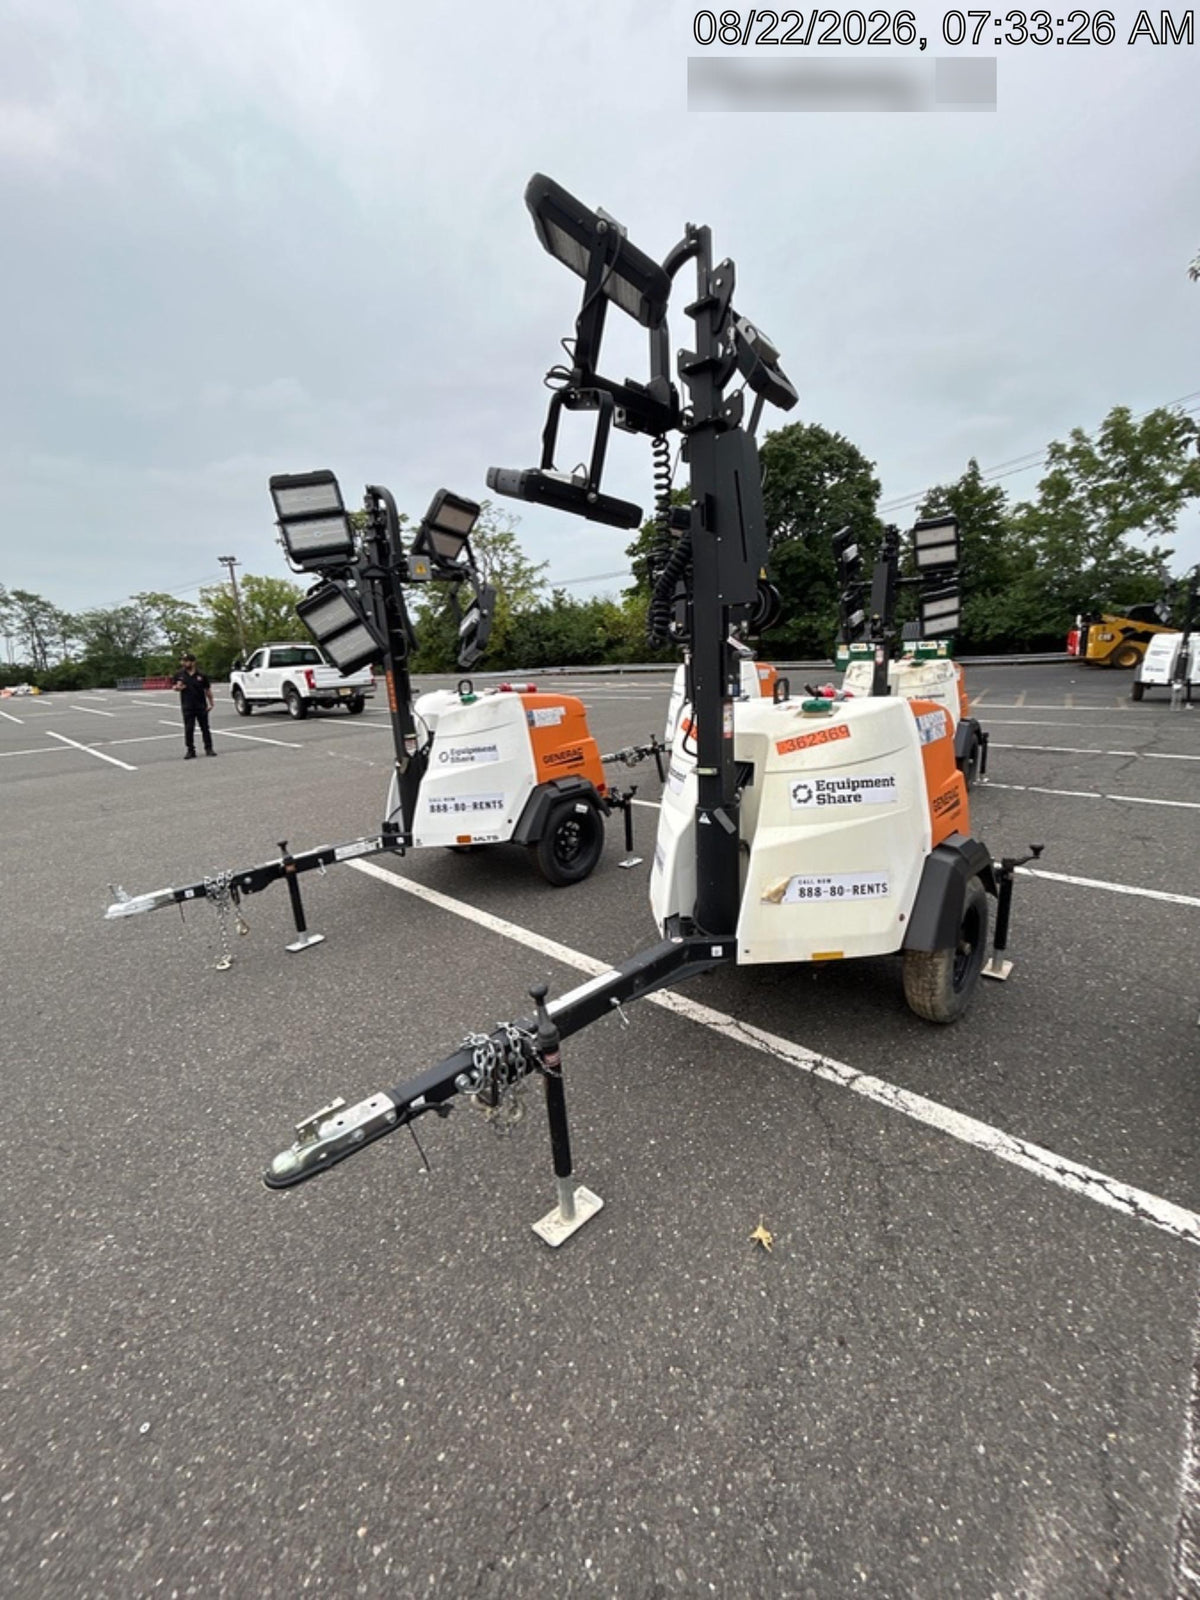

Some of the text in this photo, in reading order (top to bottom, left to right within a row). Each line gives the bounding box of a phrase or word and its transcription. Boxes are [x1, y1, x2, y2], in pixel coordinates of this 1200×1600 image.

[786, 724, 850, 753] 362369
[543, 747, 583, 765] GENERAC
[815, 776, 895, 793] Equipment
[429, 800, 504, 814] 888-80-RENTS
[816, 793, 862, 805] Share
[798, 882, 888, 899] 888-80-RENTS
